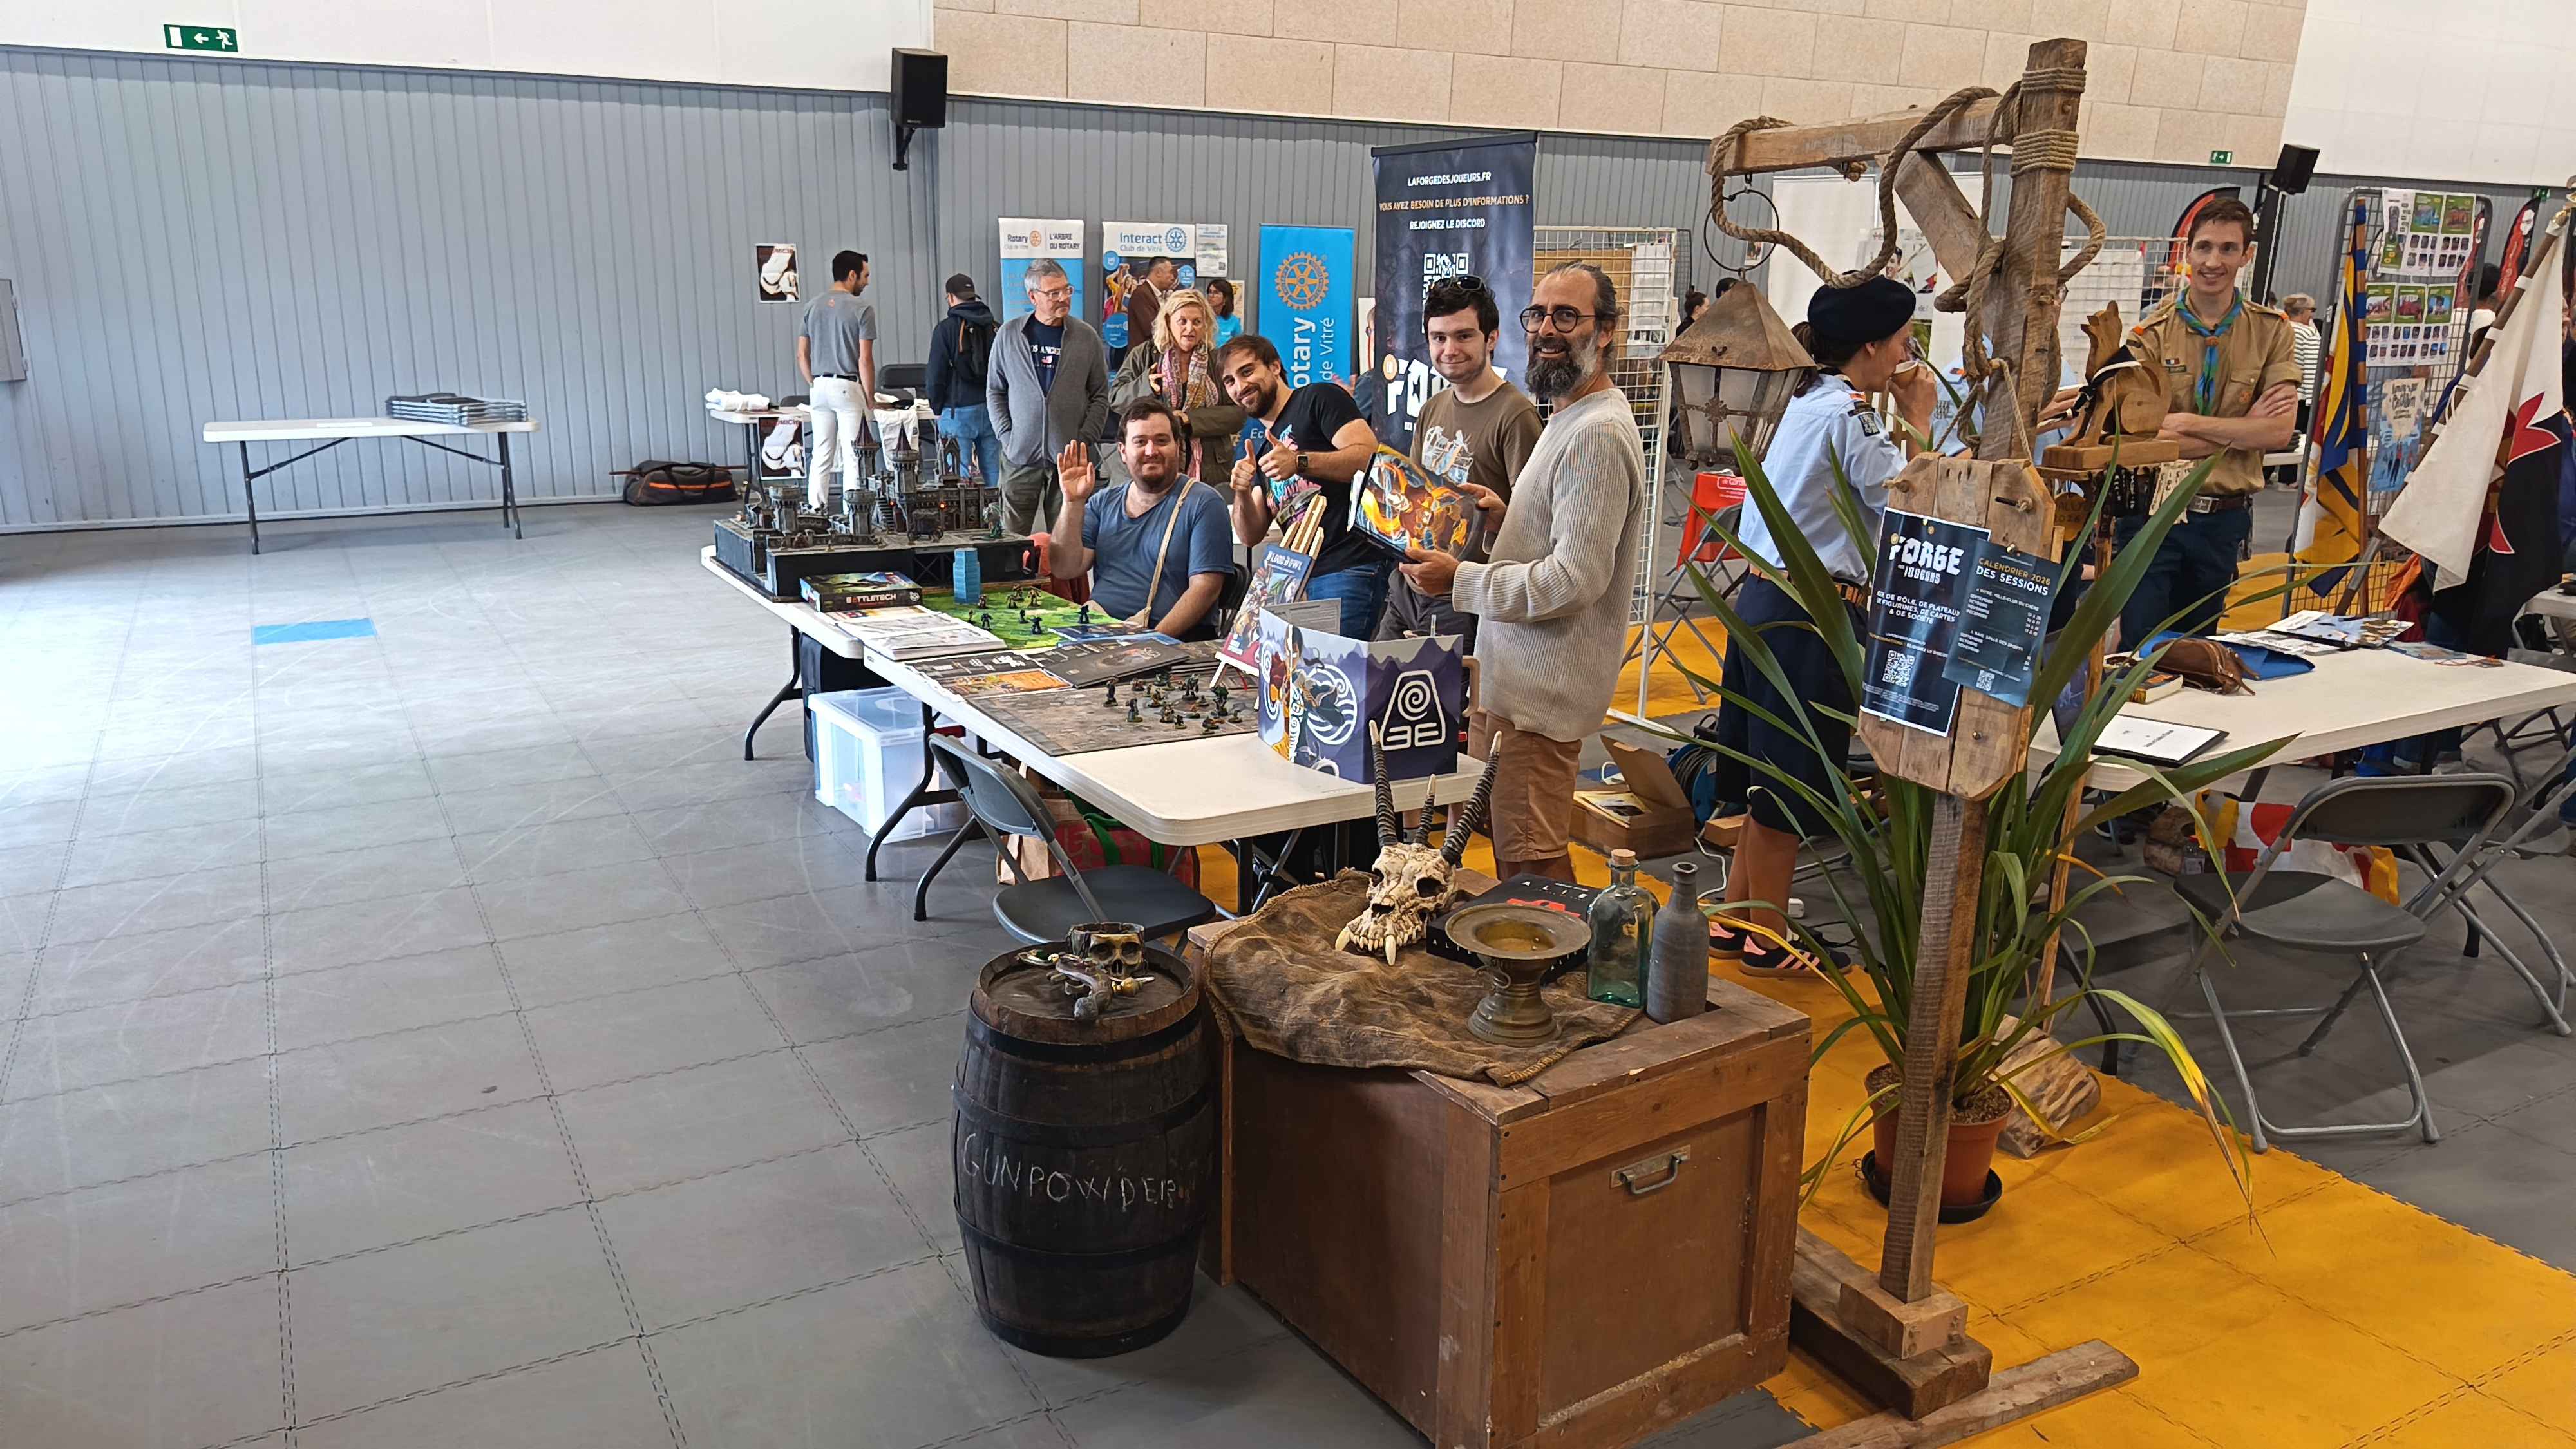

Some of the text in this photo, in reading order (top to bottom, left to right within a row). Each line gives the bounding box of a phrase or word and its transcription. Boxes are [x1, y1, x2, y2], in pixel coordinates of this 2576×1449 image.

[1408, 172, 1492, 187] LAFORGEDESJOUEURS.FR
[1379, 201, 1392, 211] VOUS
[1393, 200, 1409, 211] AVEZ
[1410, 200, 1434, 209] BESOIN
[1435, 199, 1444, 209] DE
[1445, 198, 1462, 208] PLUS
[1463, 195, 1524, 207] D'INFORMATIONS
[1410, 218, 1486, 230] REJOIGNEZ LE DISCORD
[1007, 234, 1028, 243] Rotary
[1119, 232, 1162, 245] Interact
[1293, 317, 1316, 389] otary
[1319, 317, 1334, 381] de Vitré
[1266, 550, 1286, 565] BLOOD
[1283, 556, 1303, 571] BOWL
[1889, 535, 1964, 576] FORGE
[1978, 557, 2029, 578] CALENDRIER
[2031, 573, 2051, 585] 2026
[1976, 565, 2049, 596] DES SESSIONS
[846, 593, 896, 603] BATTLETECH
[1930, 611, 1955, 622] CARTES
[963, 1133, 1177, 1212] GUNPOWDER
